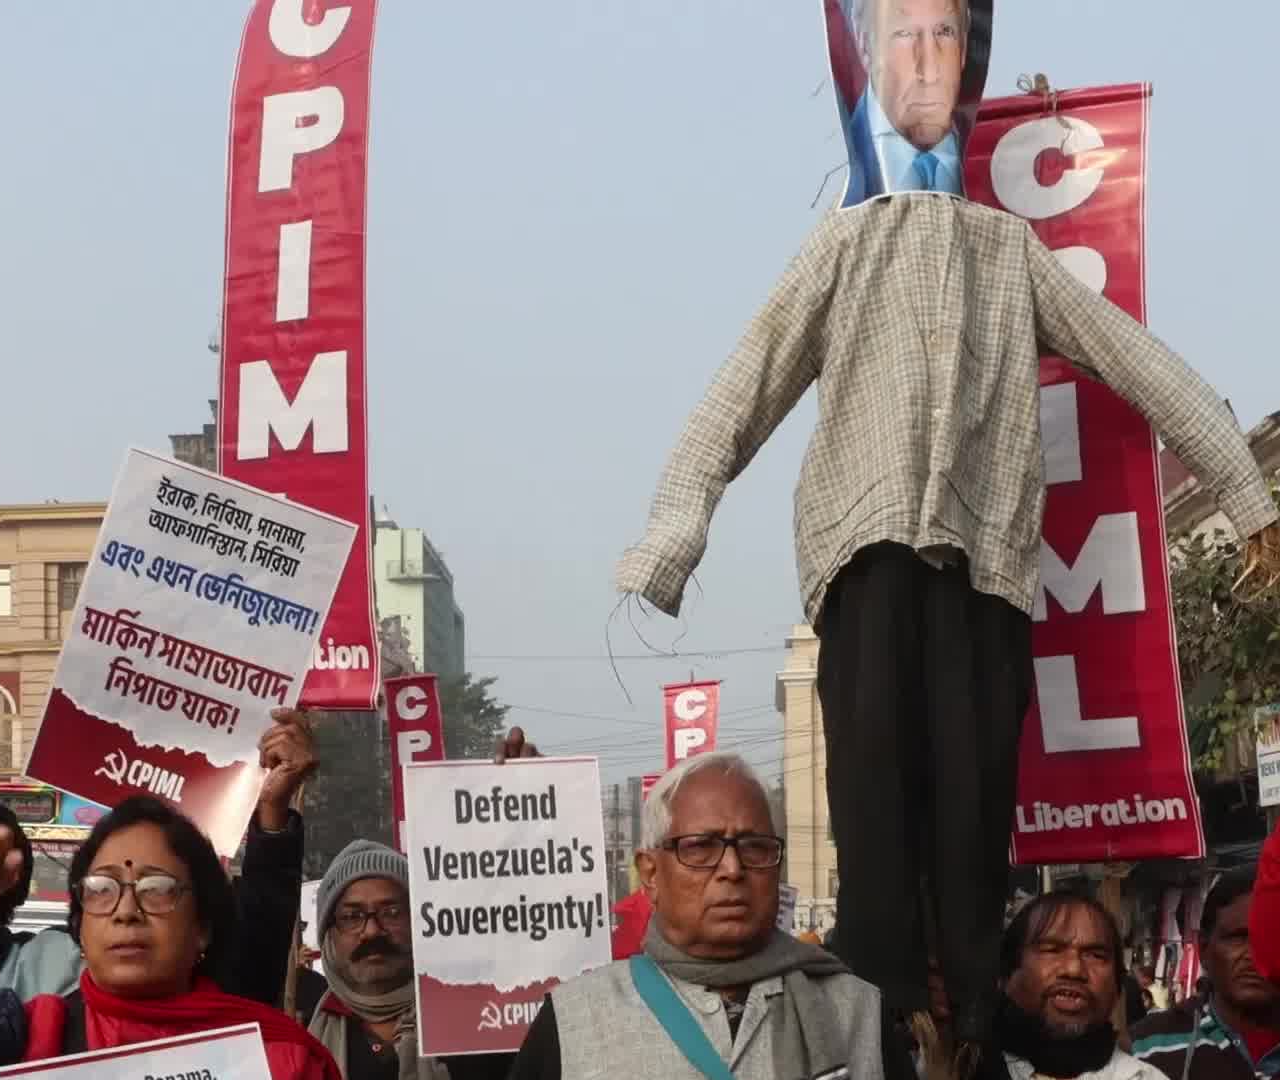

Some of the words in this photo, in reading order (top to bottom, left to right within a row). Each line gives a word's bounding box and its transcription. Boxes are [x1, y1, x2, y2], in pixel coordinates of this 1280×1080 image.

[154, 476, 200, 518] ইরাক,
[200, 492, 254, 536] লিবিয়া,
[256, 516, 306, 554] পানামা,
[250, 537, 303, 579] সিরিয়া
[100, 538, 145, 578] এবং
[146, 555, 198, 594] এখন
[195, 568, 320, 637] ভেনিজুয়েলা!
[81, 605, 155, 662] মার্কিন
[156, 632, 296, 706] সাম্রাজ্যবাদ
[103, 655, 183, 710] নিপাত
[180, 687, 241, 735] যাক!
[127, 758, 187, 804] CPIML
[454, 784, 557, 825] Defend
[1015, 792, 1188, 834] Liberation
[423, 837, 595, 881] Venezuela's
[421, 893, 604, 940] Sovereignty!
